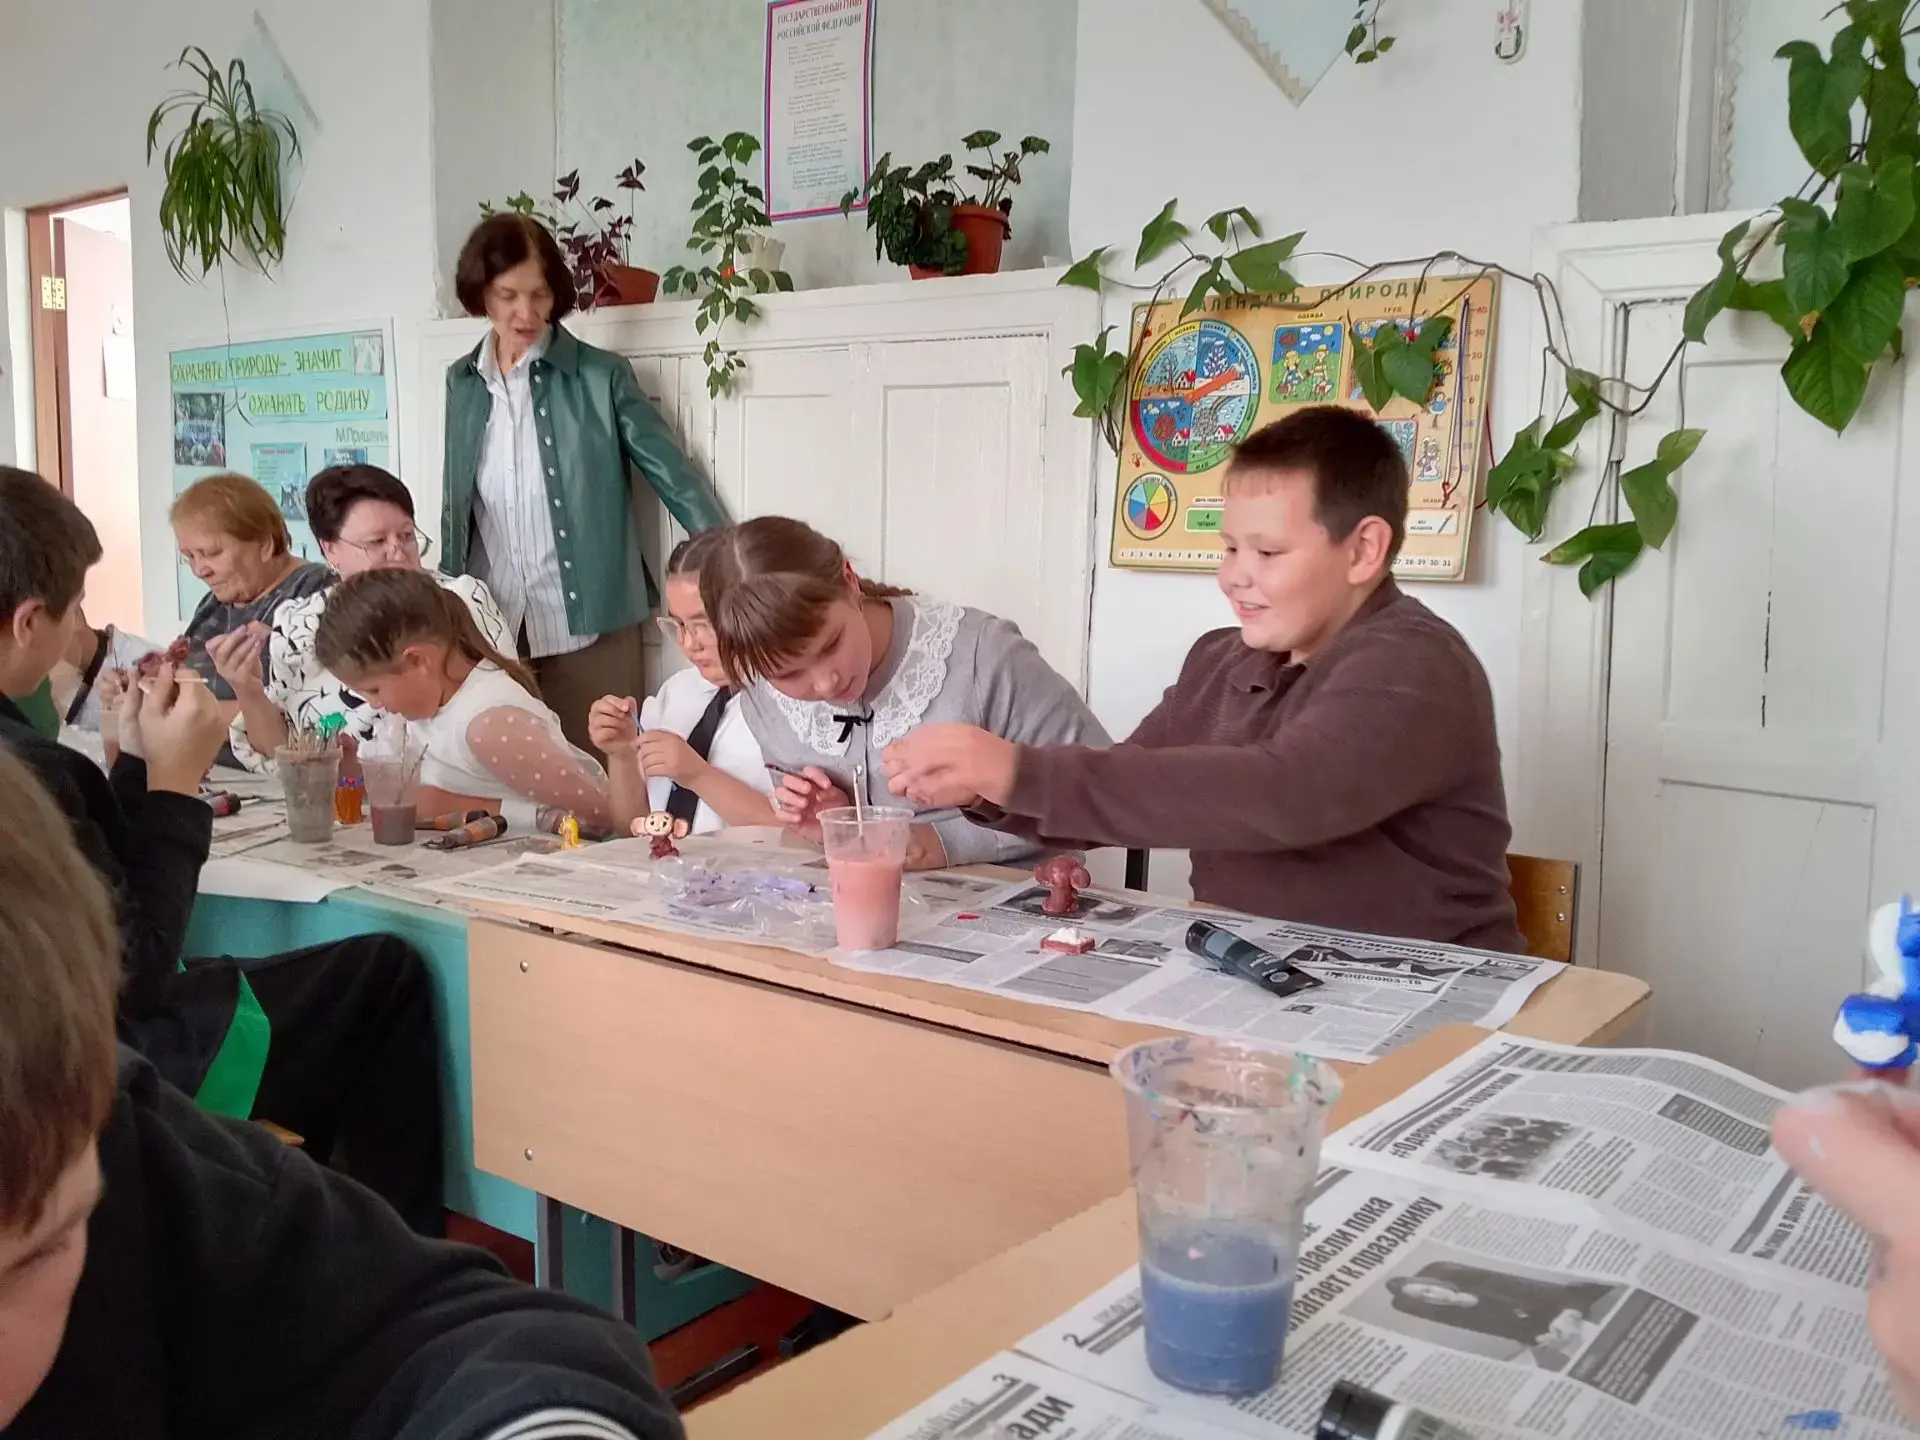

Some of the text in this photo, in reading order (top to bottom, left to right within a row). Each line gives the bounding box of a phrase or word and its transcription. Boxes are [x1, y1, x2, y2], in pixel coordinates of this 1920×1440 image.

[776, 12, 862, 40] РОССИЙСКОЙ ФЕДЕРАЦИИ
[777, 2, 842, 25] ГОСУДАРСТВЕННЫЙ
[1319, 279, 1427, 302] ПРИРОДЫ
[171, 362, 225, 384] ОХРАНЯТЬ
[295, 348, 342, 372] ЗНАЧИТ
[249, 389, 371, 415] ОХРАНЯТЬ РОДИНУ
[1342, 1196, 1394, 1234] пока
[1348, 1196, 1445, 1271] празднику
[1336, 1264, 1366, 1281] к
